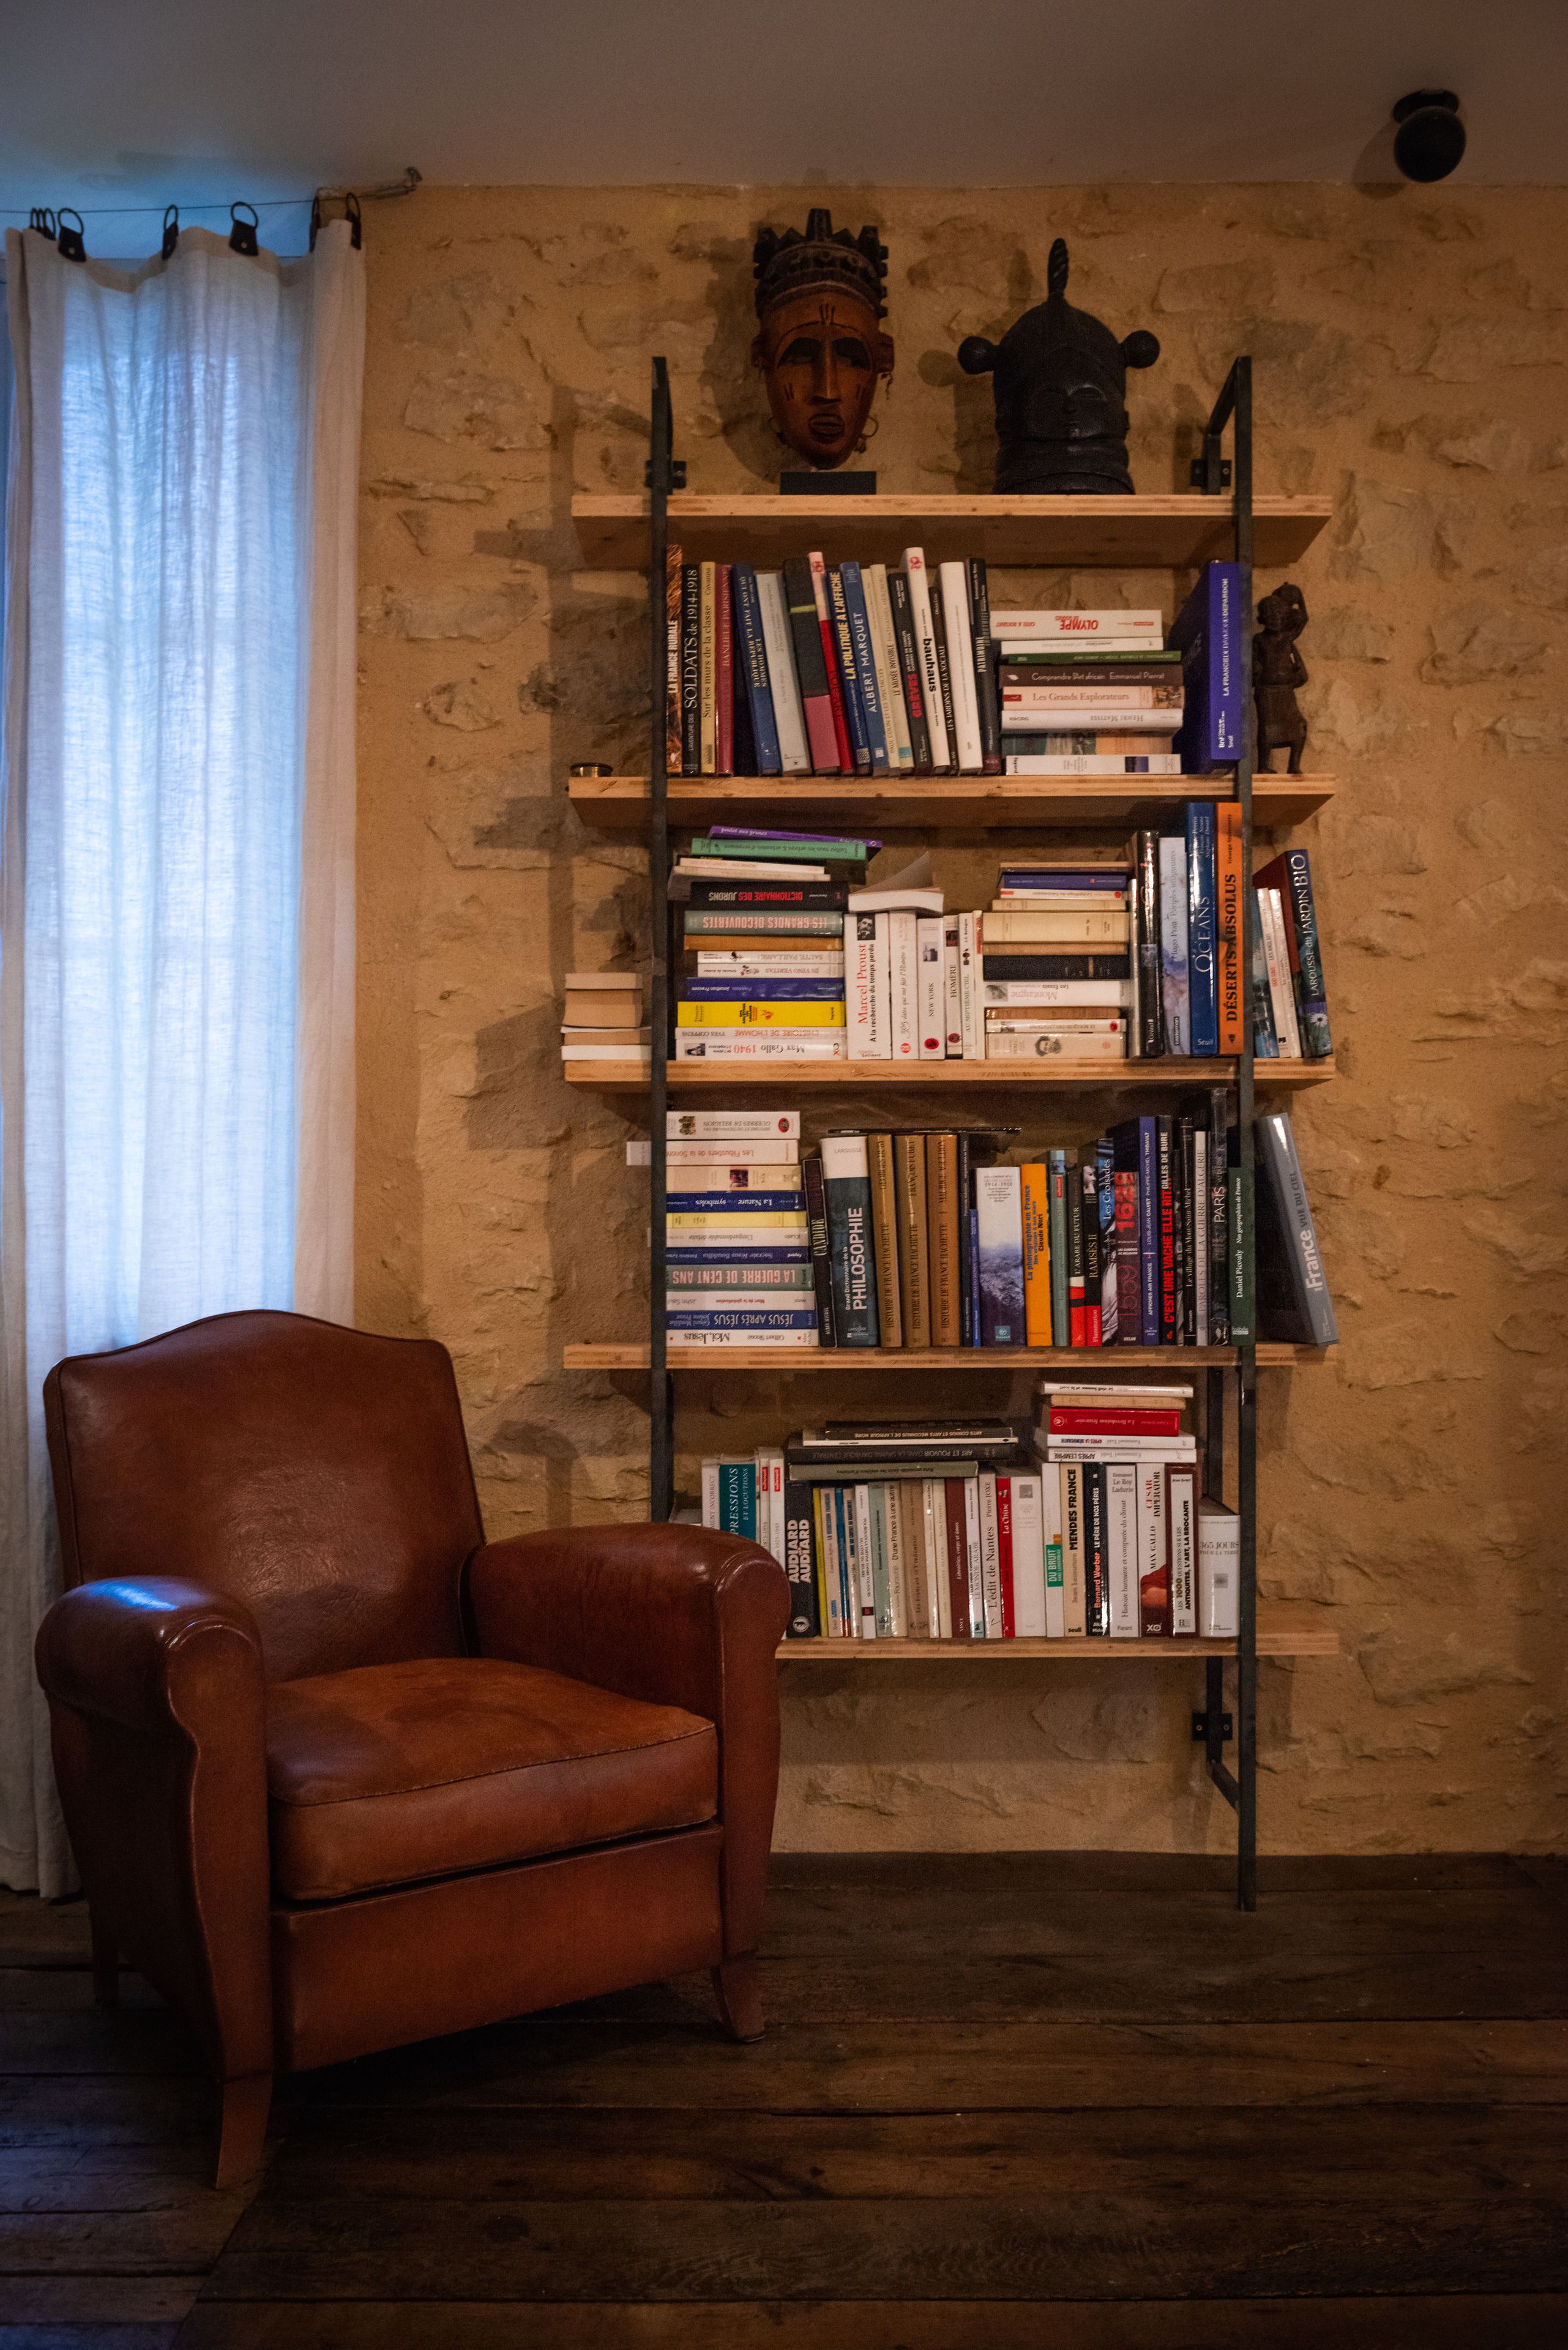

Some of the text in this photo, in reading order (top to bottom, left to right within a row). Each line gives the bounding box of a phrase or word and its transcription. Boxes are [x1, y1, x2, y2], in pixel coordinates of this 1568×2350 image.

[831, 572, 843, 612] L'AFFICHE
[684, 570, 698, 709] SOLDATS de 1914-1918
[853, 613, 870, 666] MARQUET
[1059, 620, 1098, 630] OLYMPE
[668, 621, 678, 693] LA FRANCE RURALE
[841, 622, 854, 666] POLITIQUE
[975, 636, 986, 673] PATRIMOINE
[846, 668, 856, 679] LA
[922, 638, 937, 692] bauhaus
[863, 673, 878, 713] ALBERT
[908, 673, 922, 718] GRÈVES
[1080, 693, 1129, 702] Explorateurs
[709, 892, 737, 901] JURONS
[1225, 874, 1236, 944] ABSOLUS
[703, 917, 827, 930] LES GRANDES DÉCOUVERTES
[1290, 854, 1319, 996] LAROUSSE du JARDIN BIO
[857, 944, 868, 1023] Marcel Proust
[1010, 990, 1057, 999] Montaigne
[1223, 950, 1238, 1021] DÉSERTS
[734, 1044, 804, 1054] Max Gallo 1940
[1161, 1153, 1168, 1163] DE
[1102, 1158, 1111, 1201] Croisades
[1025, 1210, 1031, 1220] en
[1114, 1172, 1135, 1232] 1629
[1214, 1187, 1225, 1222] PARIS
[811, 1218, 827, 1256] CANDIDE
[1073, 1233, 1080, 1242] DU
[1162, 1210, 1173, 1233] ELLE
[909, 1224, 919, 1260] HACHETTE
[1025, 1223, 1034, 1270] photographie
[1162, 1236, 1173, 1269] VACHE
[848, 1207, 867, 1310] PHILOSOPHIE
[1085, 1243, 1097, 1278] RAMSÈS
[1235, 1250, 1244, 1274] Picouly
[672, 1270, 796, 1285] LA GUERRE DE CENT ANS
[939, 1223, 949, 1329] HISTOIRE DE FRANCE HACHETTE
[1026, 1272, 1032, 1280] La
[1163, 1270, 1174, 1291] UNE
[911, 1288, 920, 1297] DE
[1164, 1294, 1174, 1322] C'EST
[714, 1314, 793, 1327] JÉSUS APRÈS JÉSUS
[912, 1299, 921, 1329] HISTOIRE
[684, 1333, 709, 1344] Jésus
[1068, 1469, 1077, 1508] FRANCE
[743, 1511, 749, 1520] ET
[1002, 1525, 1009, 1534] La
[1120, 1517, 1127, 1528] du
[788, 1520, 800, 1583] AUDIARD
[799, 1520, 812, 1583] AUDIARD
[986, 1527, 995, 1561] Nantes
[1121, 1529, 1130, 1557] comparée
[985, 1564, 996, 1577] de
[1048, 1549, 1057, 1581] DU BRUIT
[985, 1580, 998, 1608] L'édit
